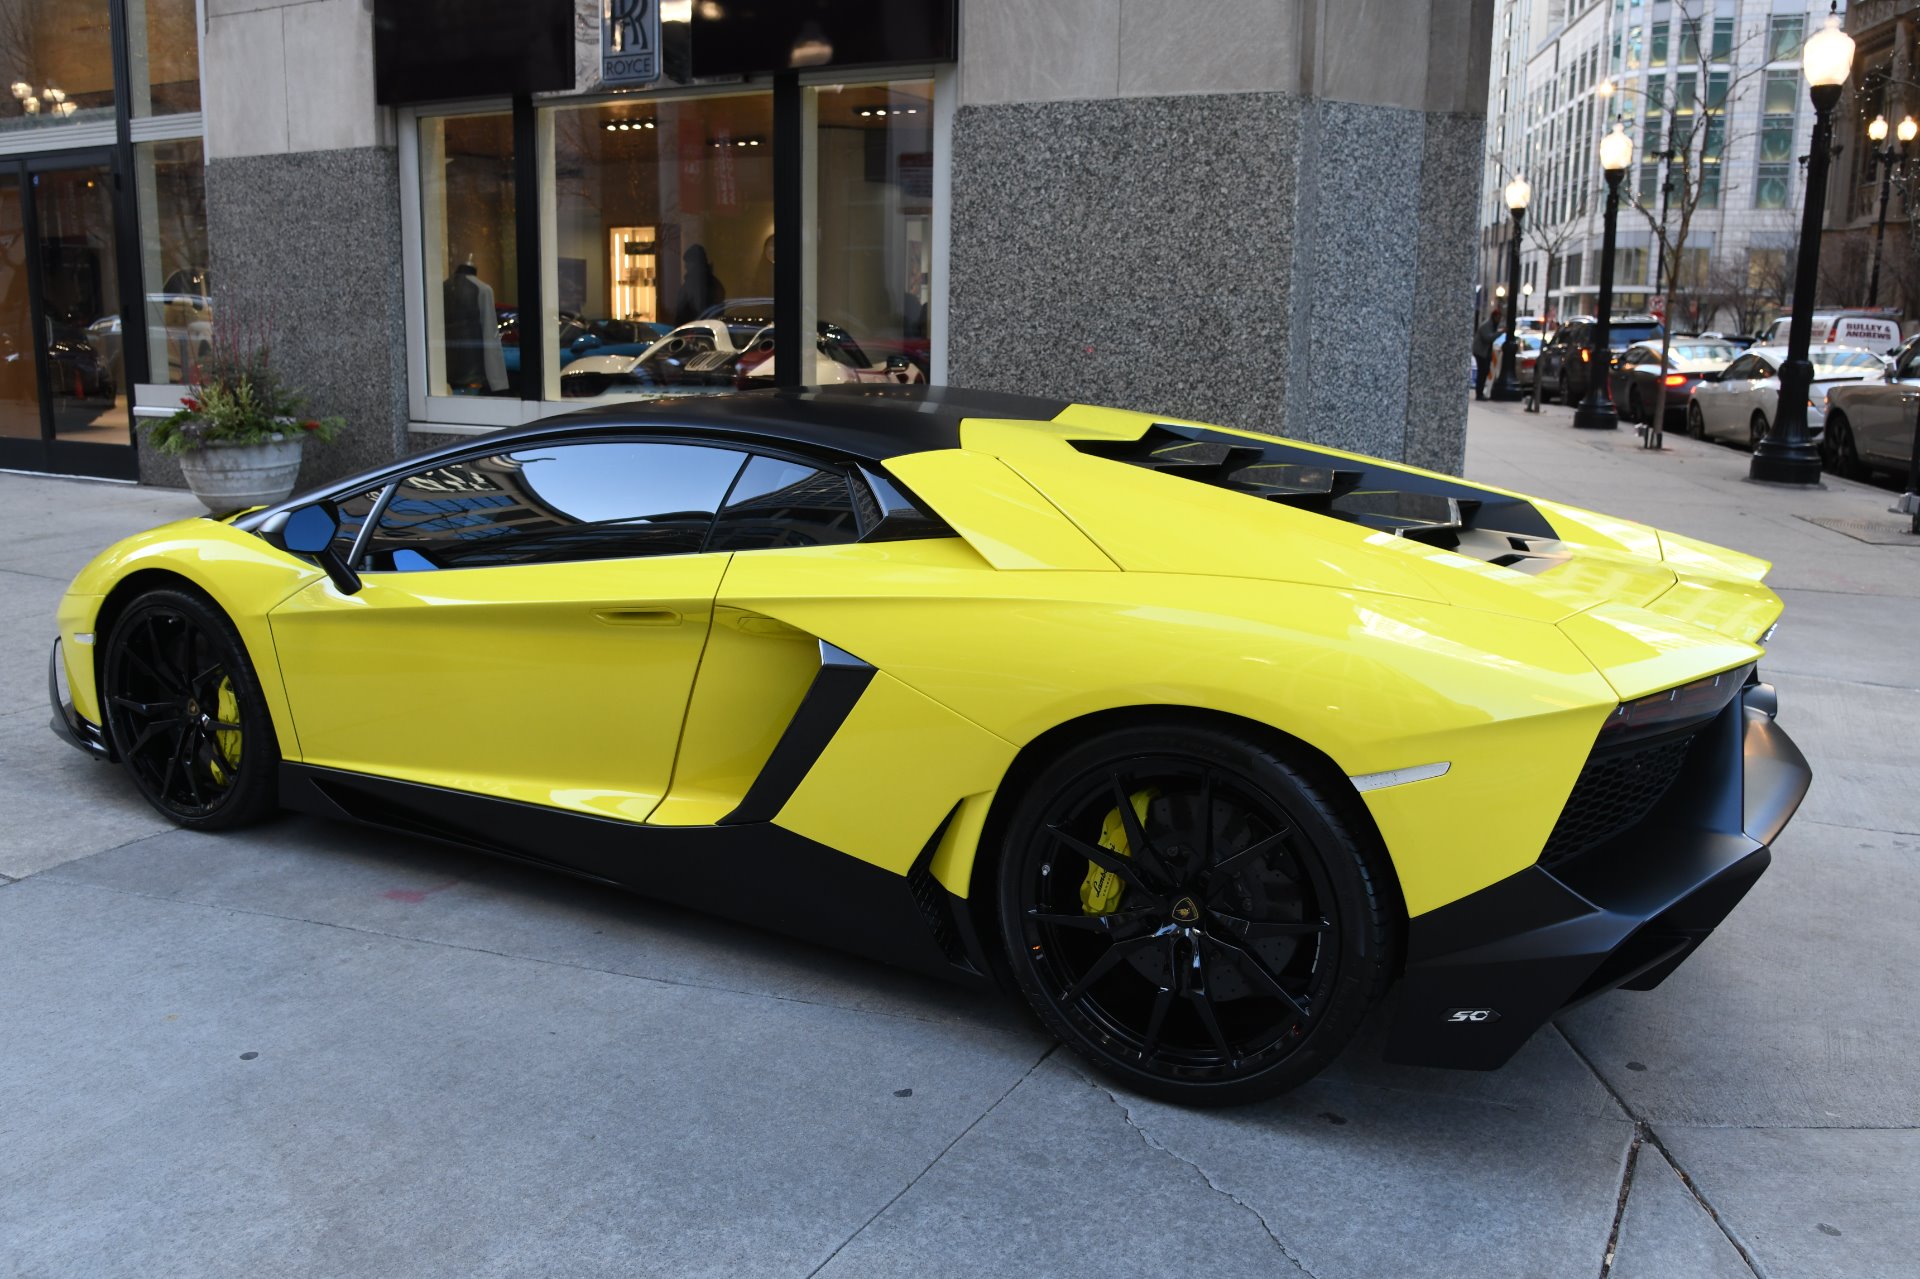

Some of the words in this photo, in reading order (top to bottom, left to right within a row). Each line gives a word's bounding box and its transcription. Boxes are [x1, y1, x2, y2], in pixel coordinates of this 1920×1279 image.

[606, 59, 651, 76] ROYCE
[1847, 323, 1882, 332] BULLEY
[1846, 331, 1891, 340] ANDREWS
